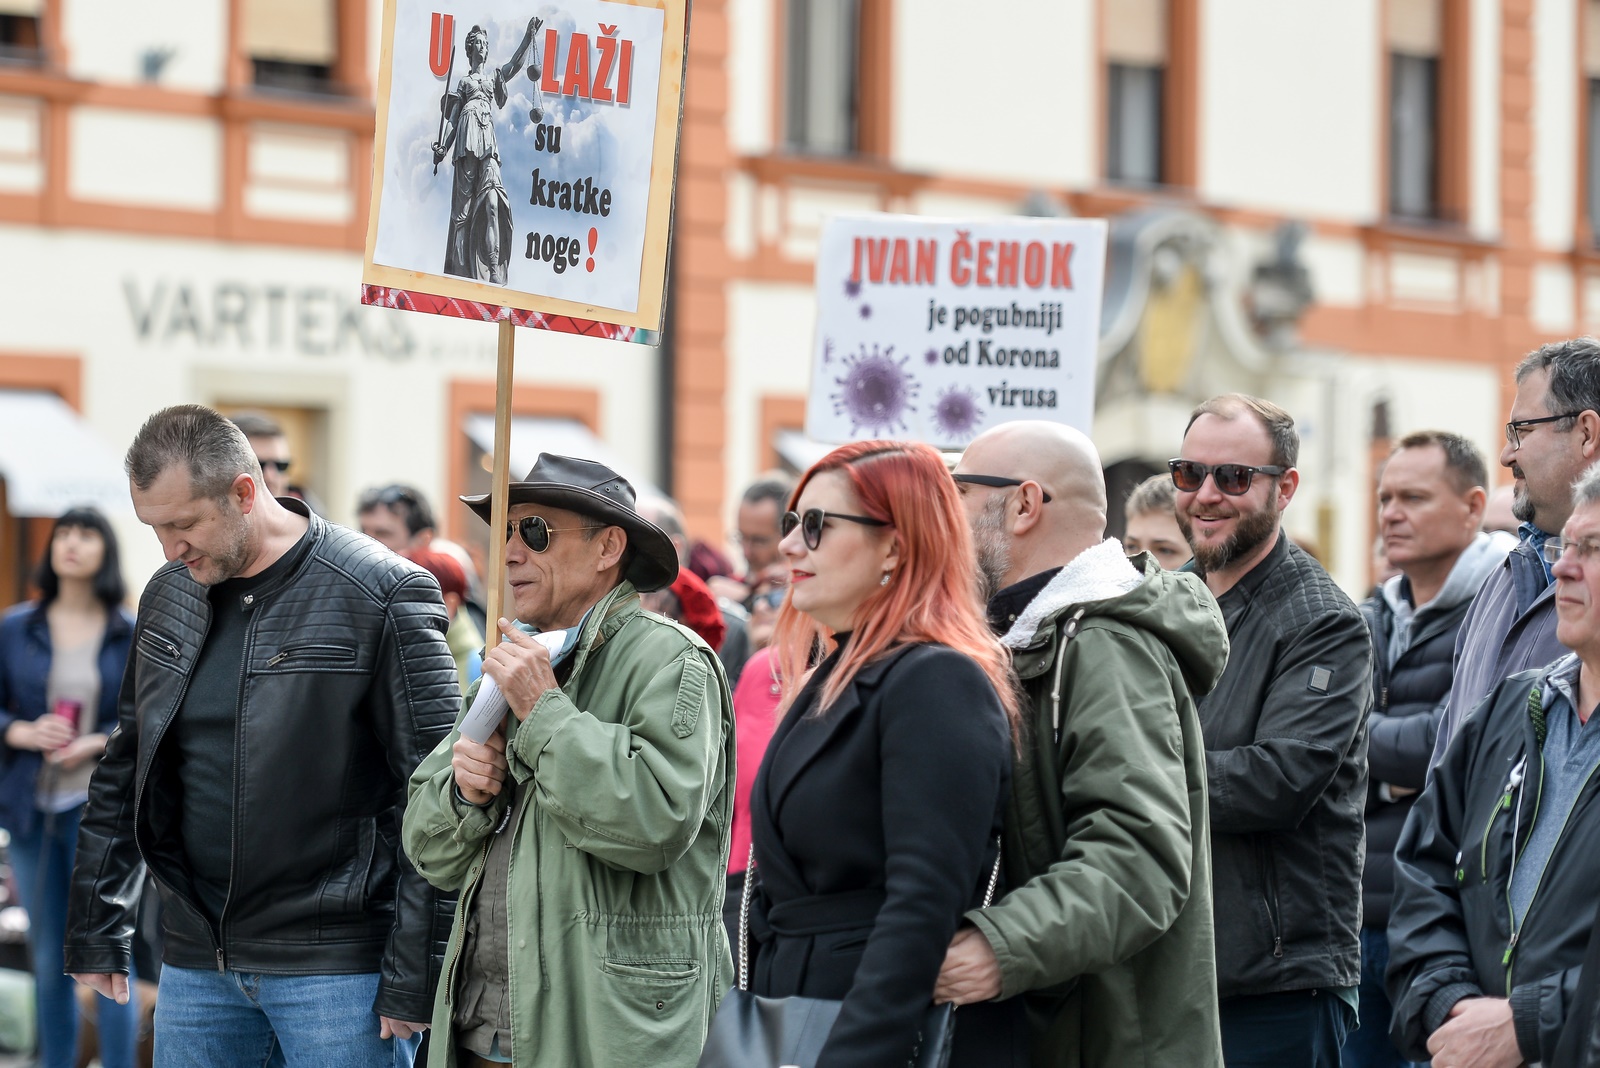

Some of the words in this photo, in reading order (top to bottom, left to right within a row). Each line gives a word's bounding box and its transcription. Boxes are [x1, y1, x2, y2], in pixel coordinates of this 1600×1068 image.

[428, 12, 454, 77] U
[540, 23, 633, 105] LAŽI
[534, 123, 561, 154] su
[529, 168, 612, 217] kratke
[851, 236, 938, 285] IVAN
[949, 229, 1075, 289] ČEHOK
[927, 299, 947, 332] je
[954, 302, 1063, 334] pogubniji
[943, 340, 969, 365] od
[977, 340, 1060, 368] Korona
[987, 380, 1058, 408] virusa
